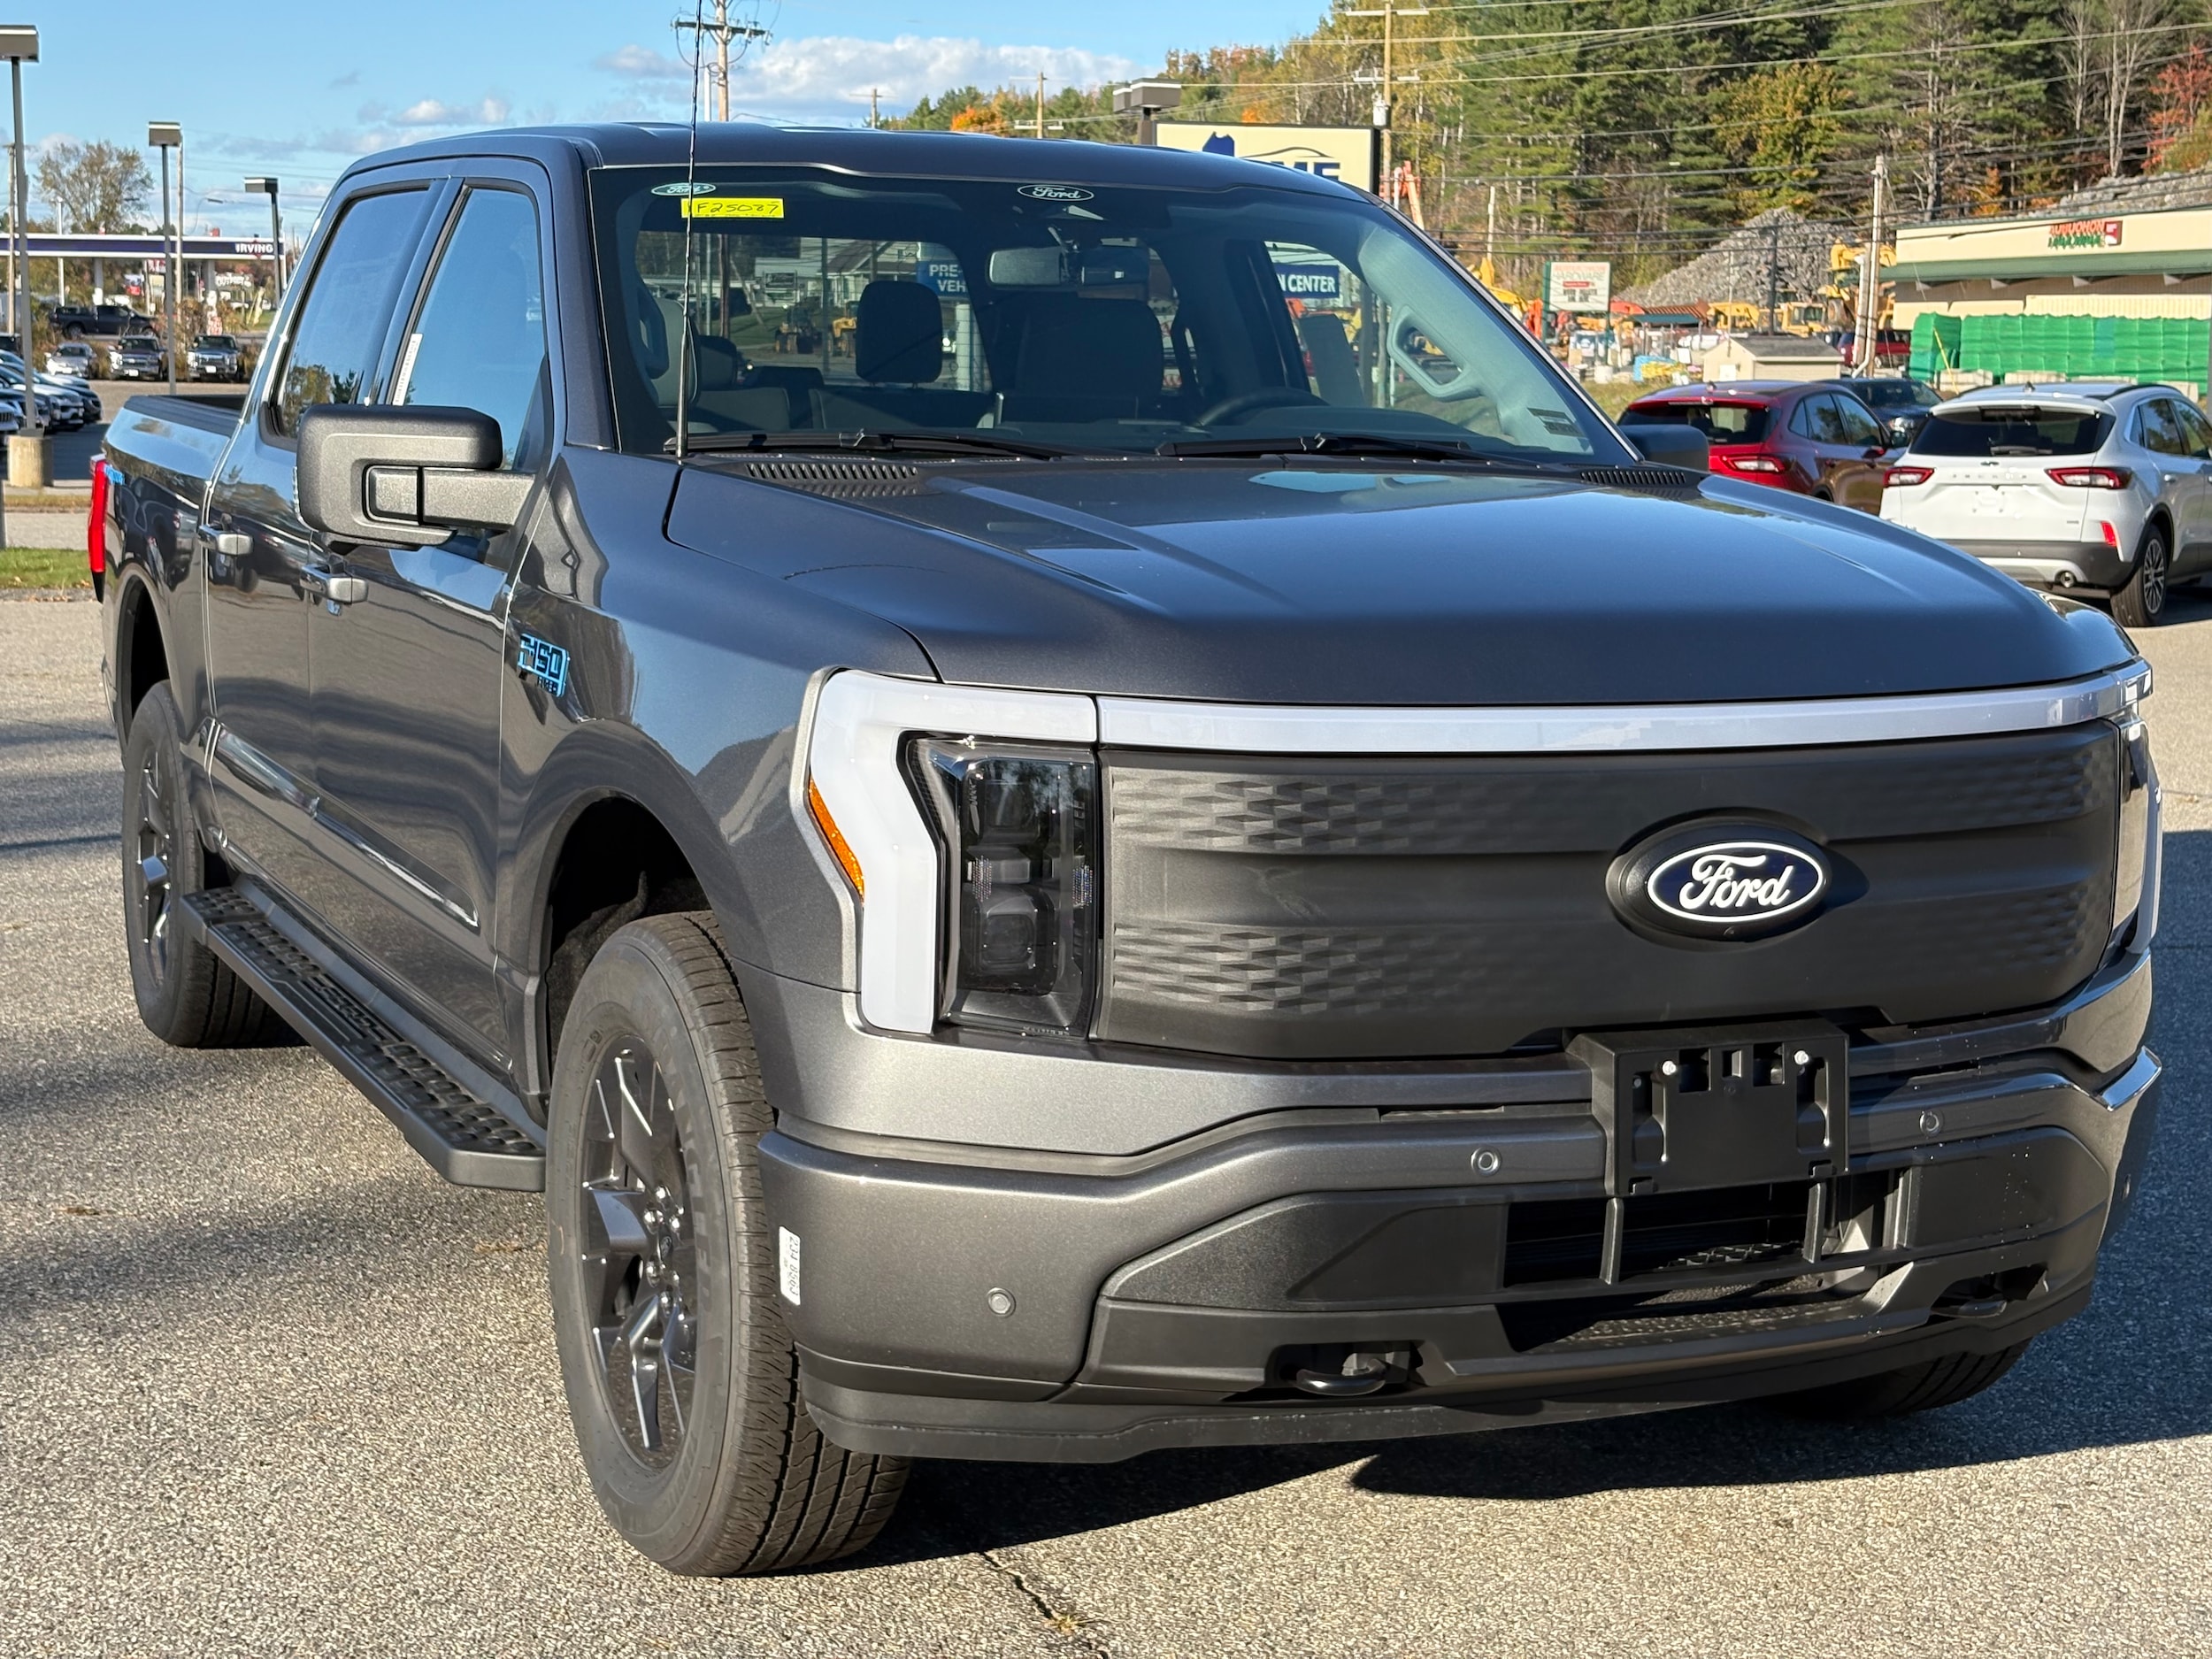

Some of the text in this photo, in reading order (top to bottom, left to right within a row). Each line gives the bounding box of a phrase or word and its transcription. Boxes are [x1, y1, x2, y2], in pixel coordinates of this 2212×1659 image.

[1032, 186, 1081, 199] Ford
[234, 242, 274, 253] IRVING
[1287, 273, 1336, 293] CENTER
[1678, 854, 1792, 910] Ford
